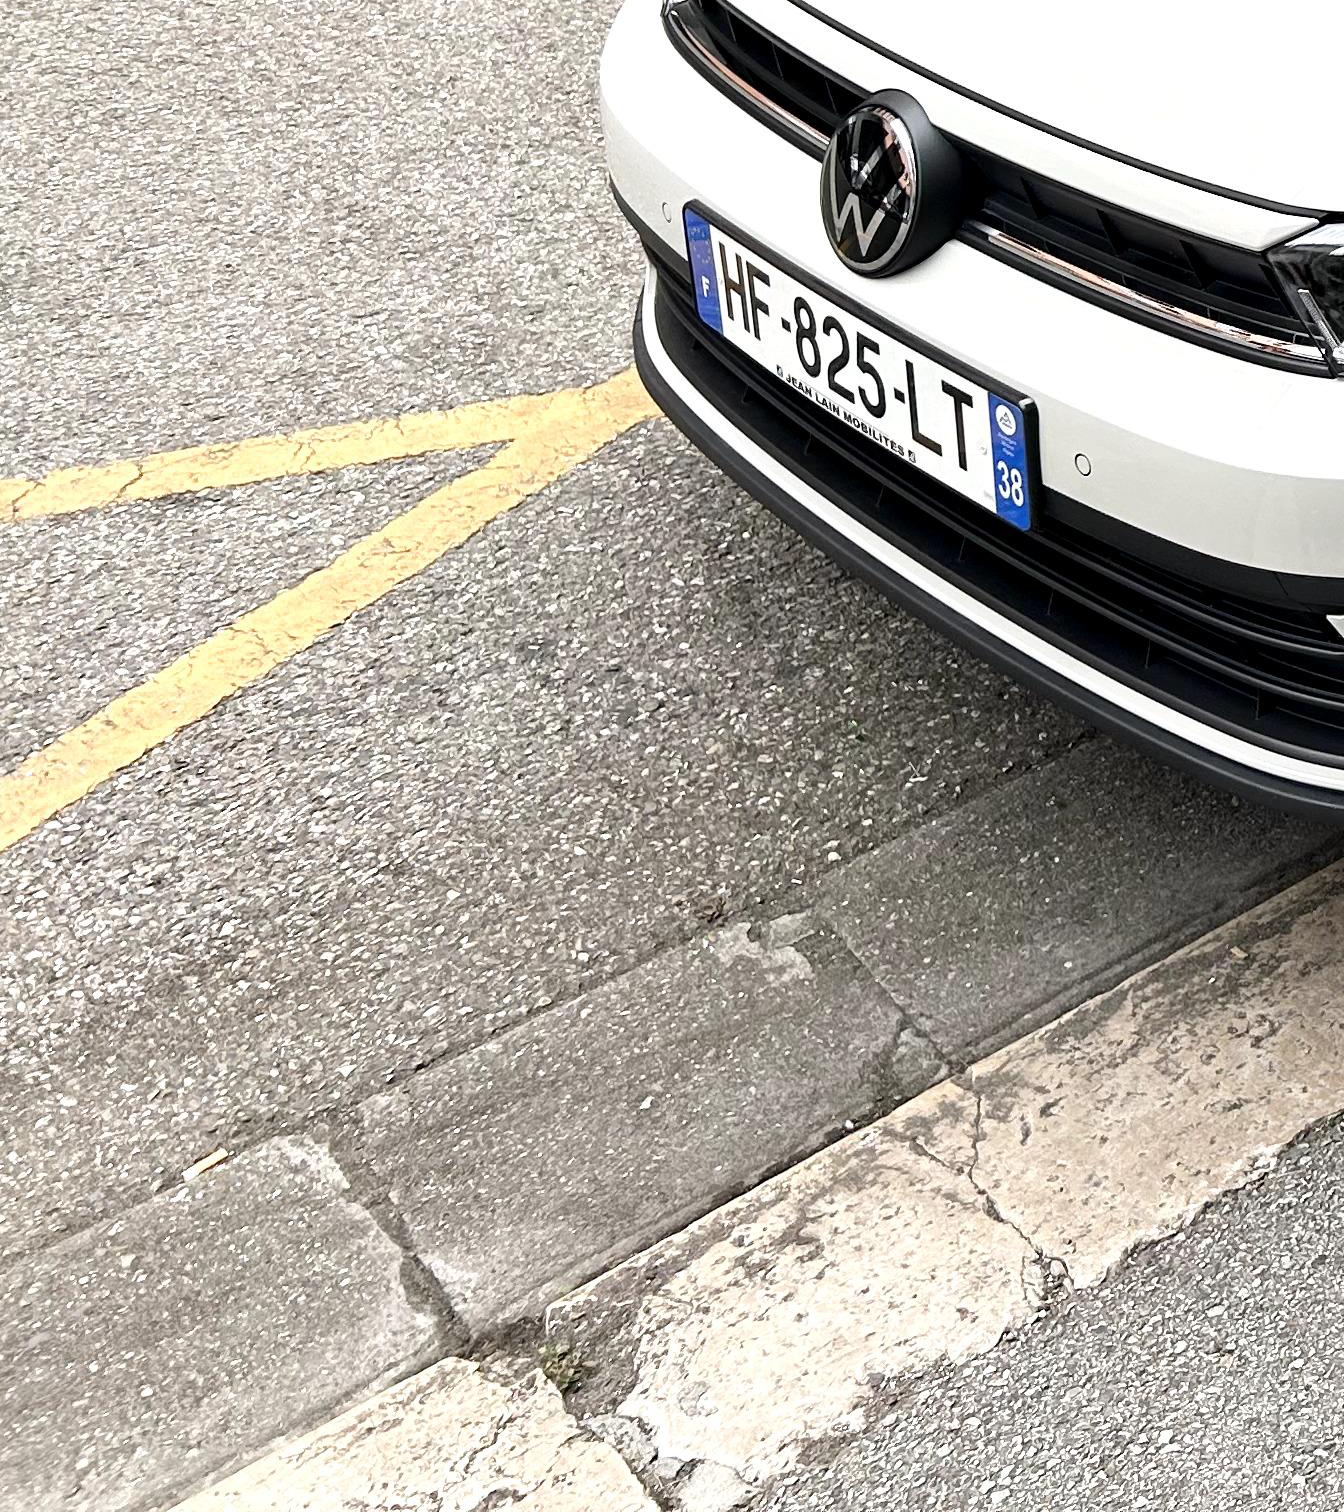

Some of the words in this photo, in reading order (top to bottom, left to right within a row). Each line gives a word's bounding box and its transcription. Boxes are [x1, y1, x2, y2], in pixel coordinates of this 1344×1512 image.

[701, 275, 710, 298] F
[719, 241, 974, 471] HF-825-LT
[785, 374, 813, 397] JEAN
[815, 392, 840, 416] LAIN
[843, 410, 905, 456] MOBILITES
[997, 460, 1024, 507] 38
